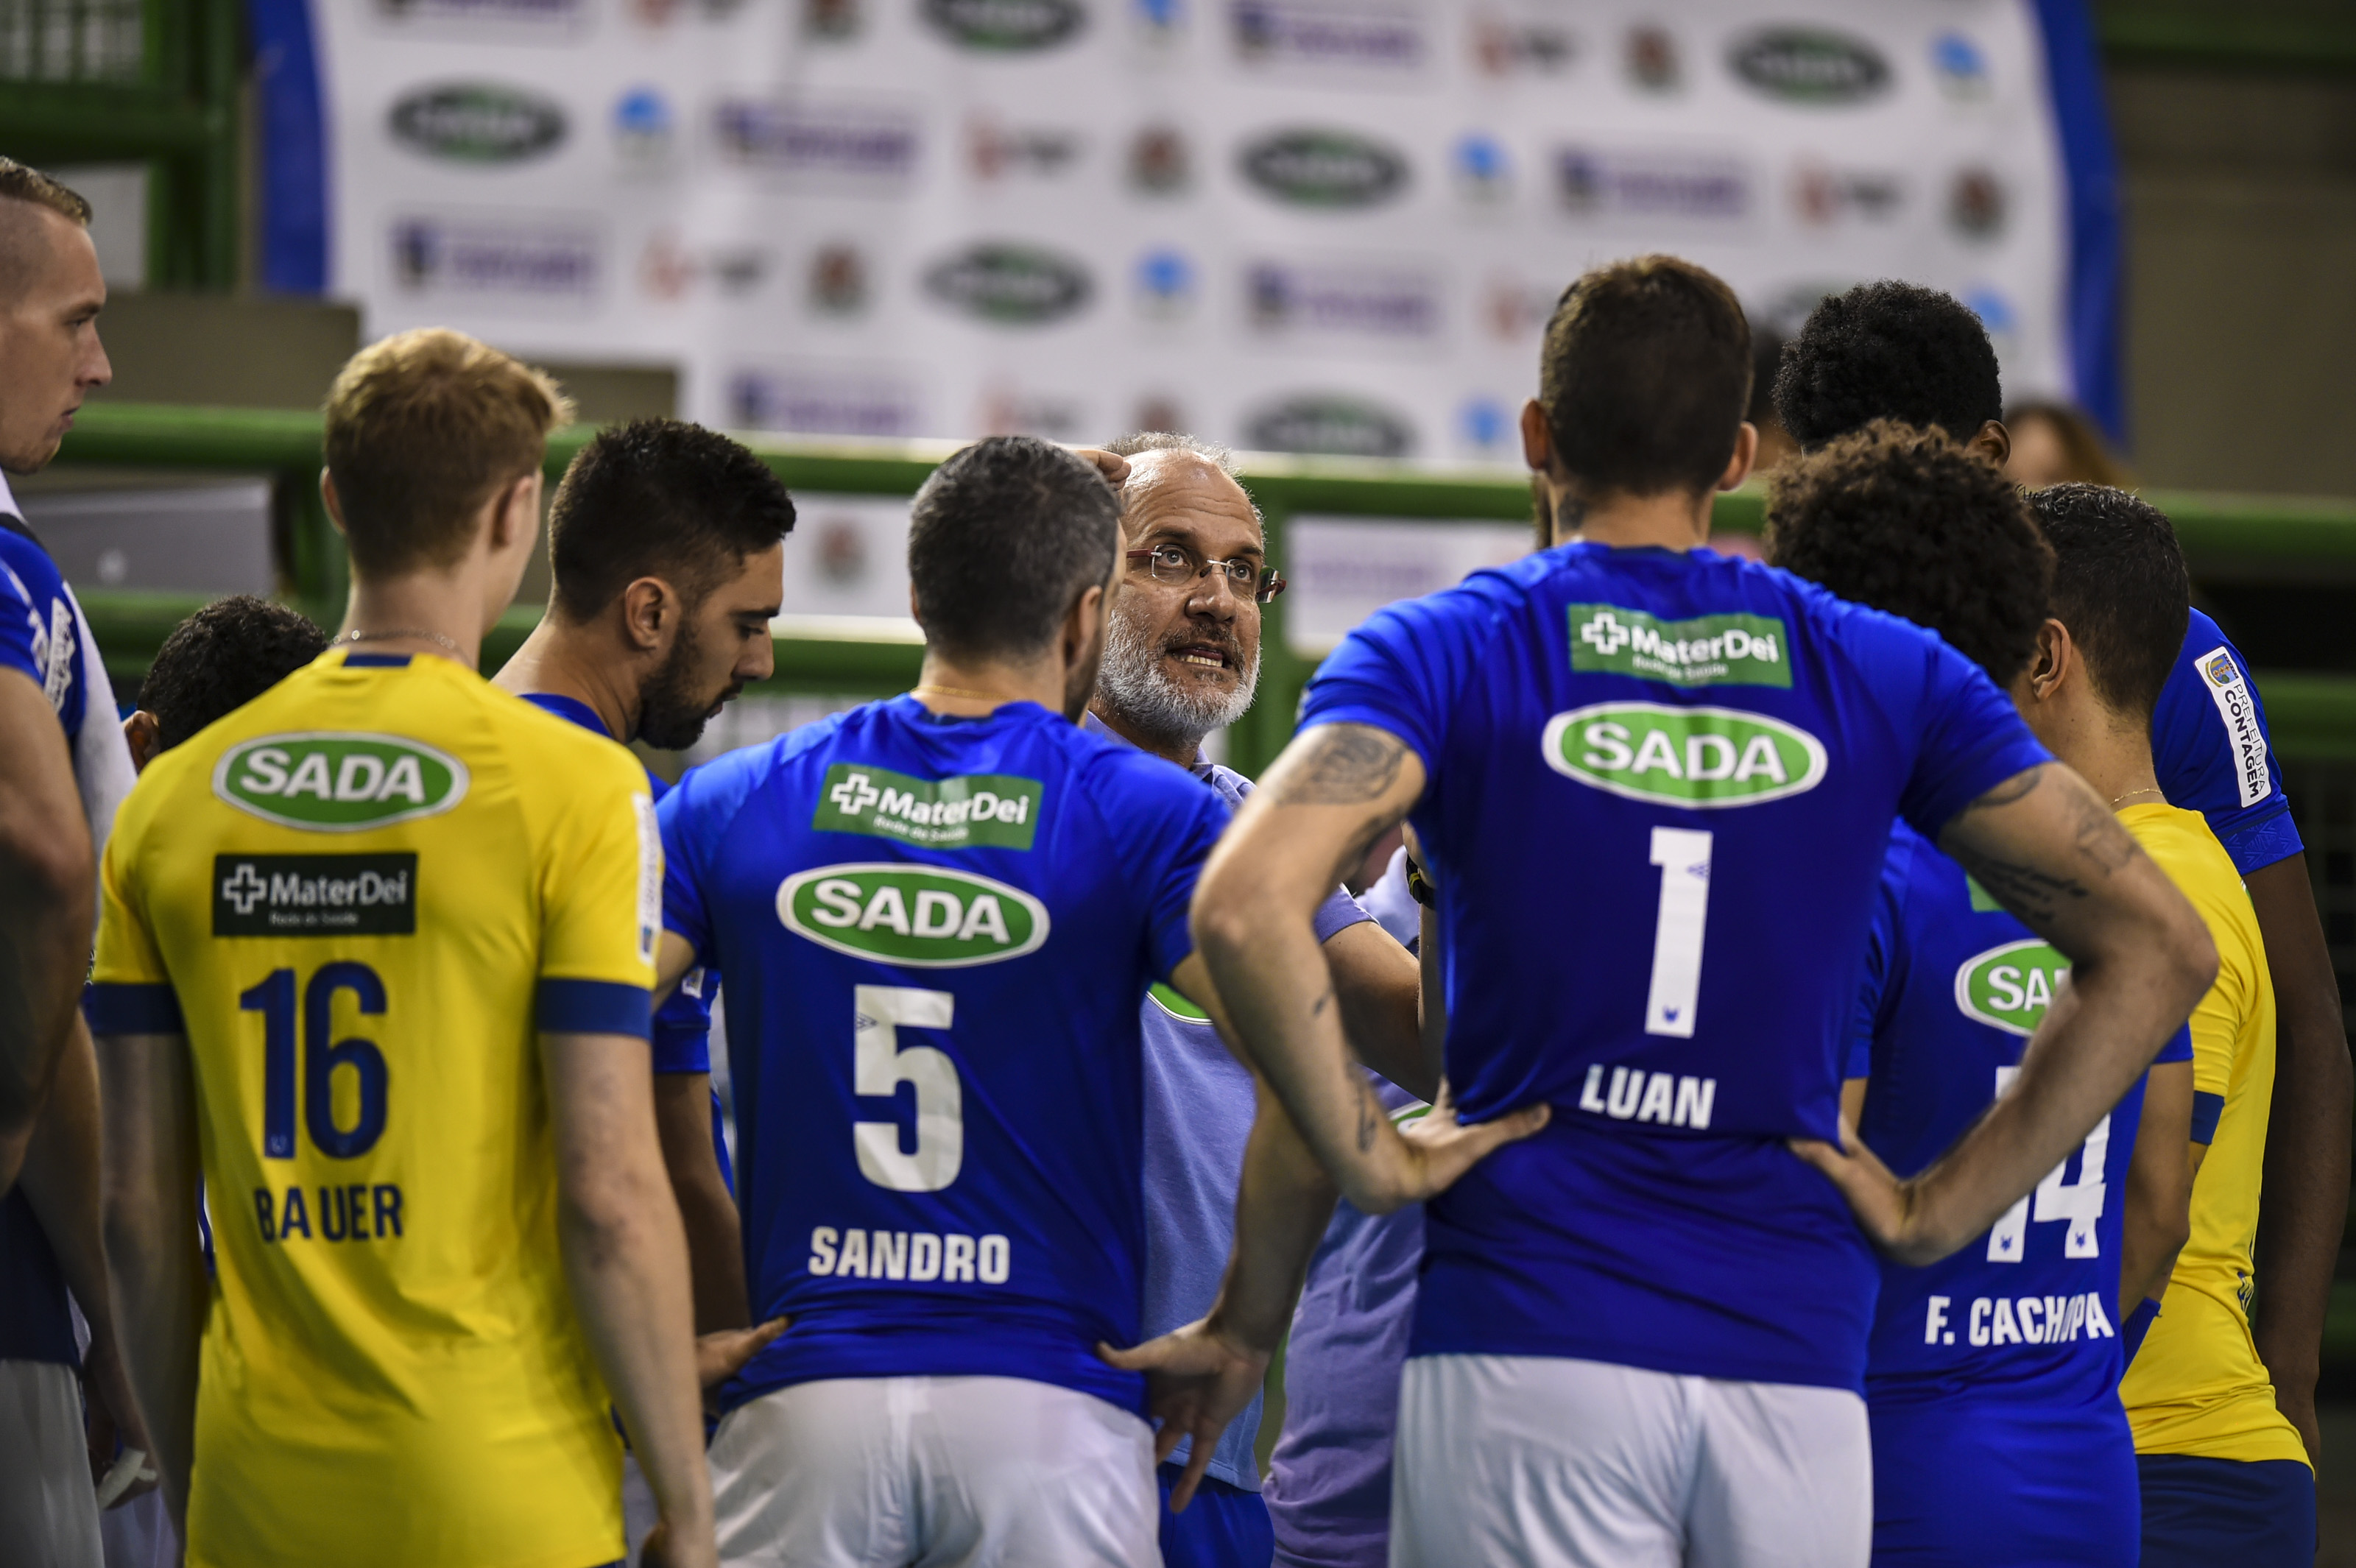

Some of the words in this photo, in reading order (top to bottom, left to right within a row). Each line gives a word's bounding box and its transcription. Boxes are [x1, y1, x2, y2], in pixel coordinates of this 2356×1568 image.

[1631, 624, 1780, 665] MaterDei
[1582, 721, 1788, 785] SADA
[2225, 689, 2260, 798] CONTAGEM
[2233, 683, 2265, 791] PREFEITURA
[239, 746, 426, 804] SADA
[878, 786, 1030, 826] MaterDei
[268, 869, 408, 907] MaterDei
[811, 878, 1012, 945] SADA
[1644, 825, 1714, 1039] 1
[1987, 964, 2070, 1012] SA
[239, 960, 389, 1160] 16
[853, 983, 964, 1193] 5
[1579, 1063, 1717, 1131] LUAN
[253, 1183, 404, 1244] BAUER
[808, 1226, 1011, 1285] SANDRO
[1924, 1295, 1955, 1346] F.
